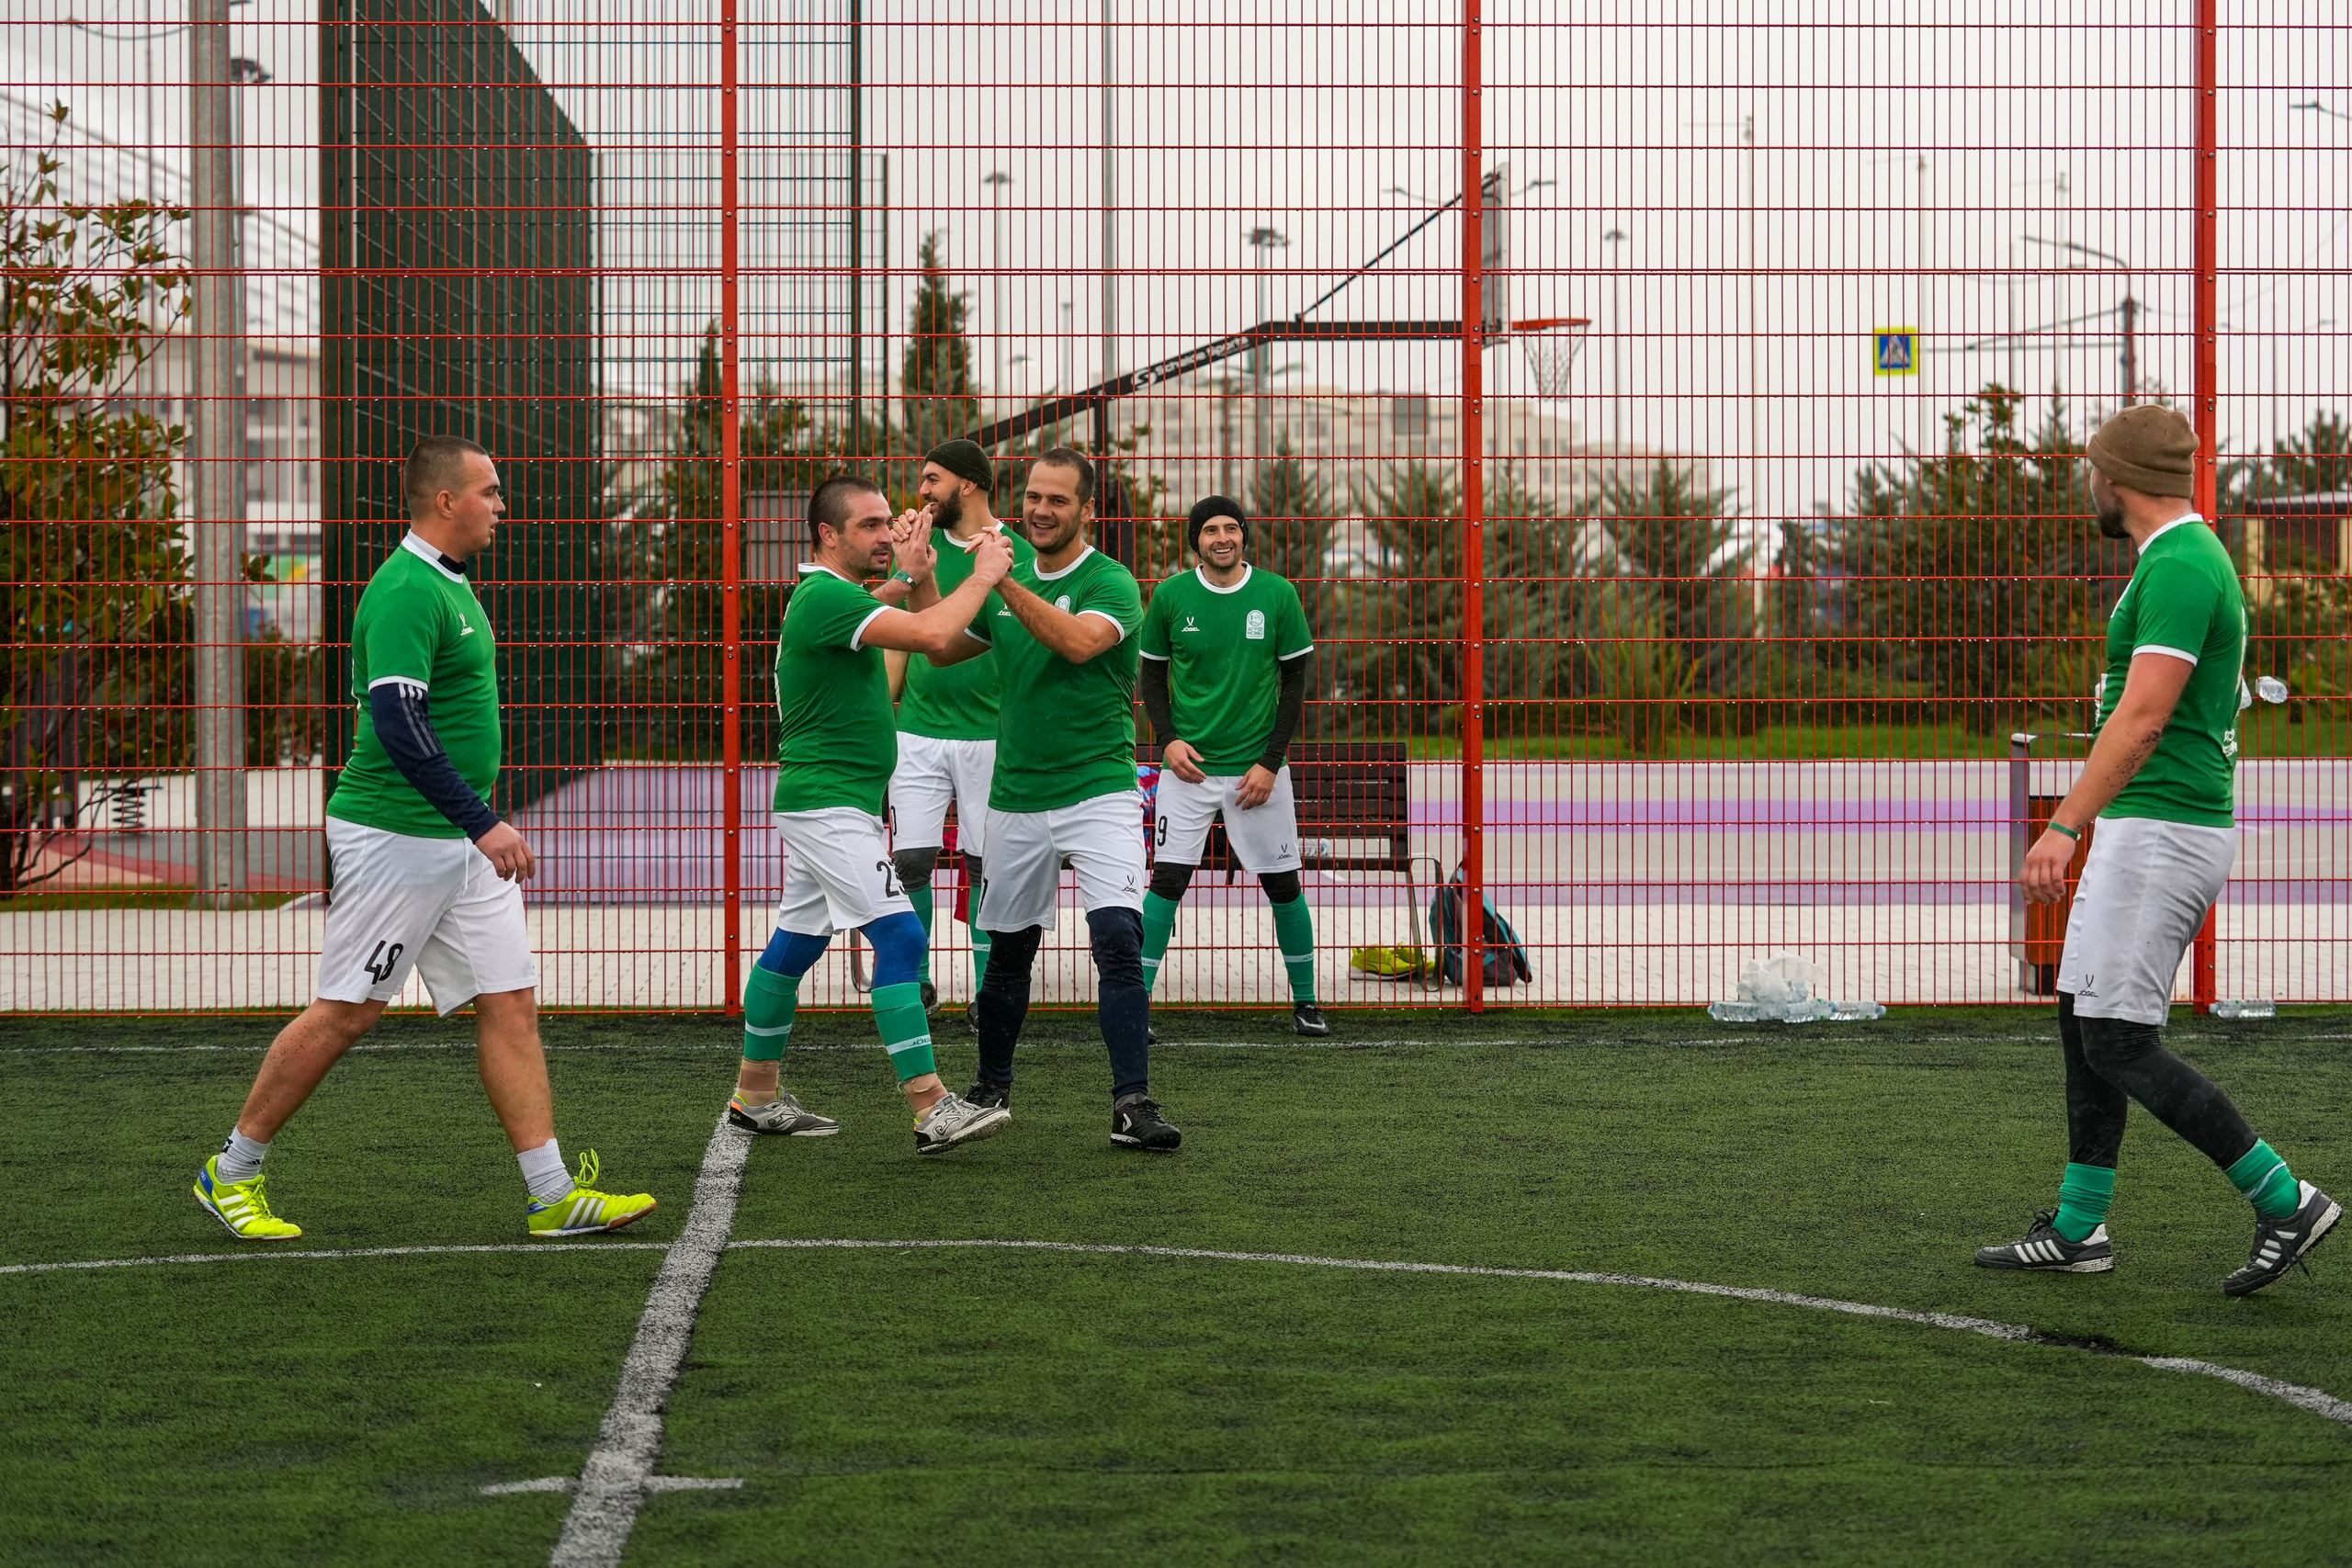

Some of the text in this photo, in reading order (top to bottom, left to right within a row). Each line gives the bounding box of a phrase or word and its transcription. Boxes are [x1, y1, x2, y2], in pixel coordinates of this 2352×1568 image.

[1157, 815, 1169, 847] 9
[364, 940, 404, 986] 48
[2077, 988, 2099, 998] JÖGEL
